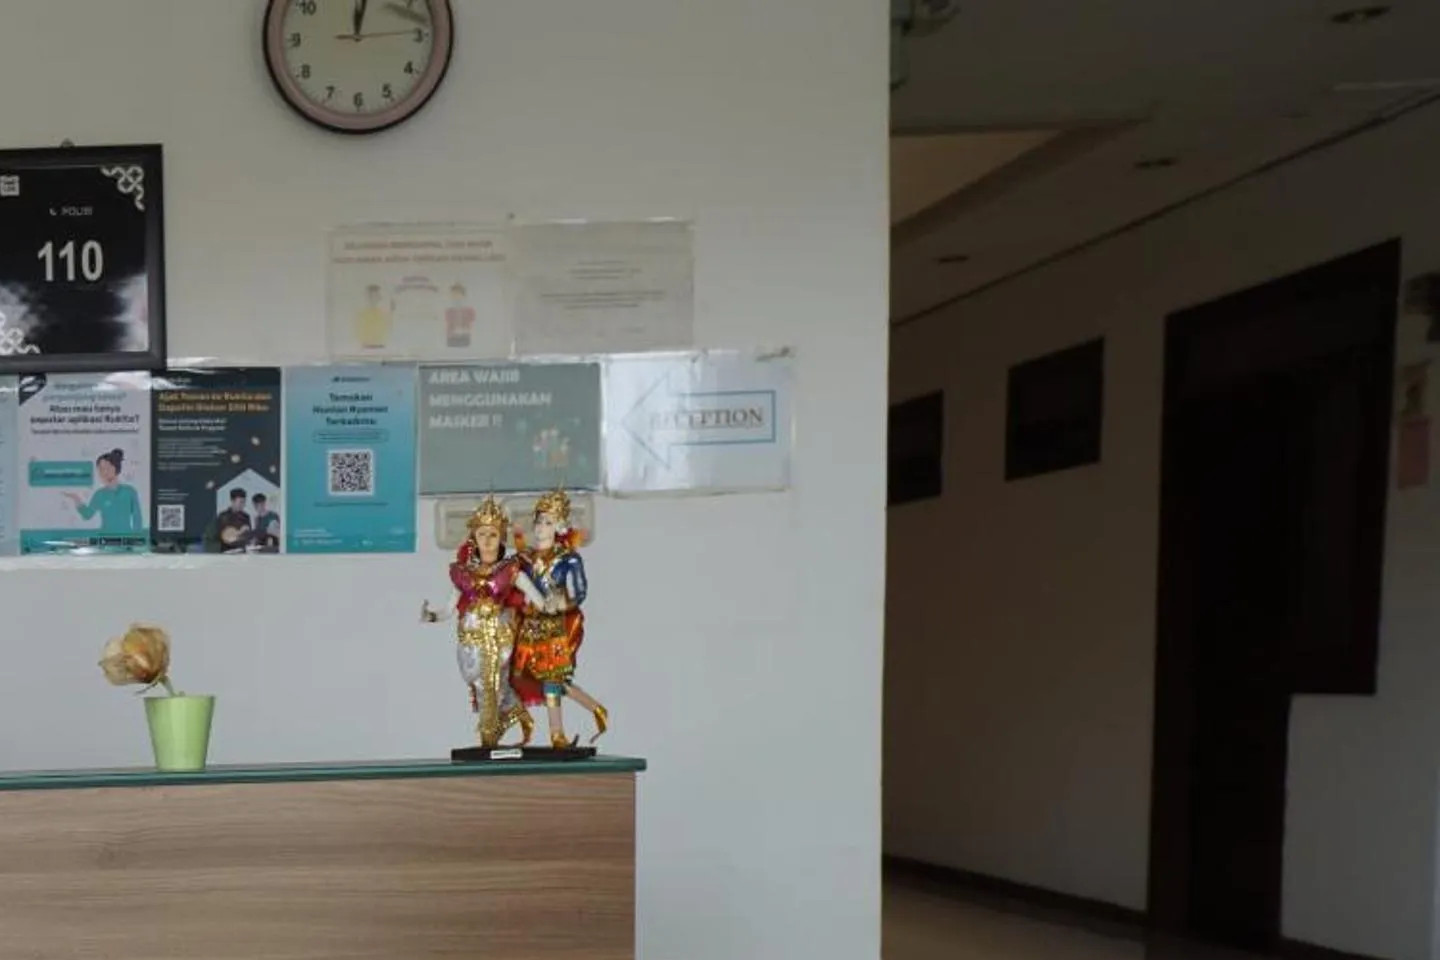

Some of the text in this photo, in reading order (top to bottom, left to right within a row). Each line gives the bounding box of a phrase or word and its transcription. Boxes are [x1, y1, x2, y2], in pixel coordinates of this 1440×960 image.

[37, 239, 104, 282] 110
[429, 368, 520, 384] AREA WAJIB
[429, 391, 553, 407] MENGGUNAKAN
[429, 413, 490, 429] MASKER
